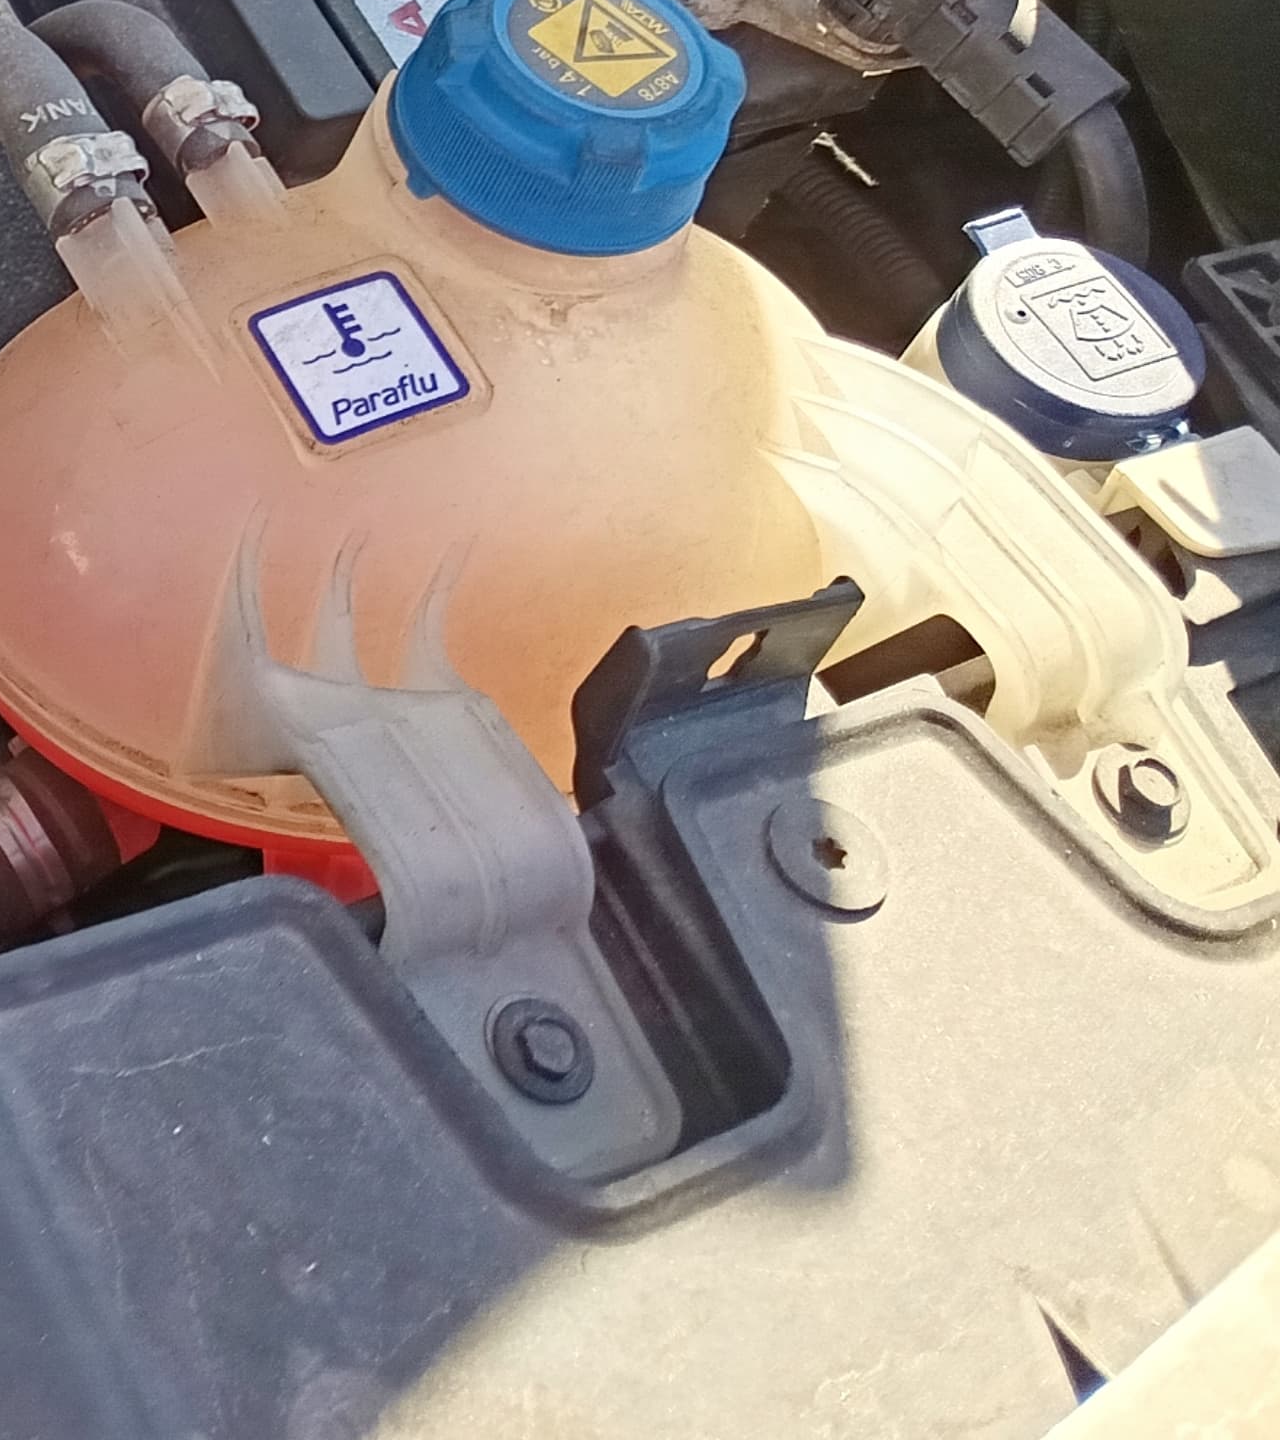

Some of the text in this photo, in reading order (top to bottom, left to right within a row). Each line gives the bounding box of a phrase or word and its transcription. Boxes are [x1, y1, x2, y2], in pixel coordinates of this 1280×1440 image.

[531, 48, 592, 97] 1.4 bar
[638, 72, 680, 101] A878
[331, 372, 439, 426] Paraflu
